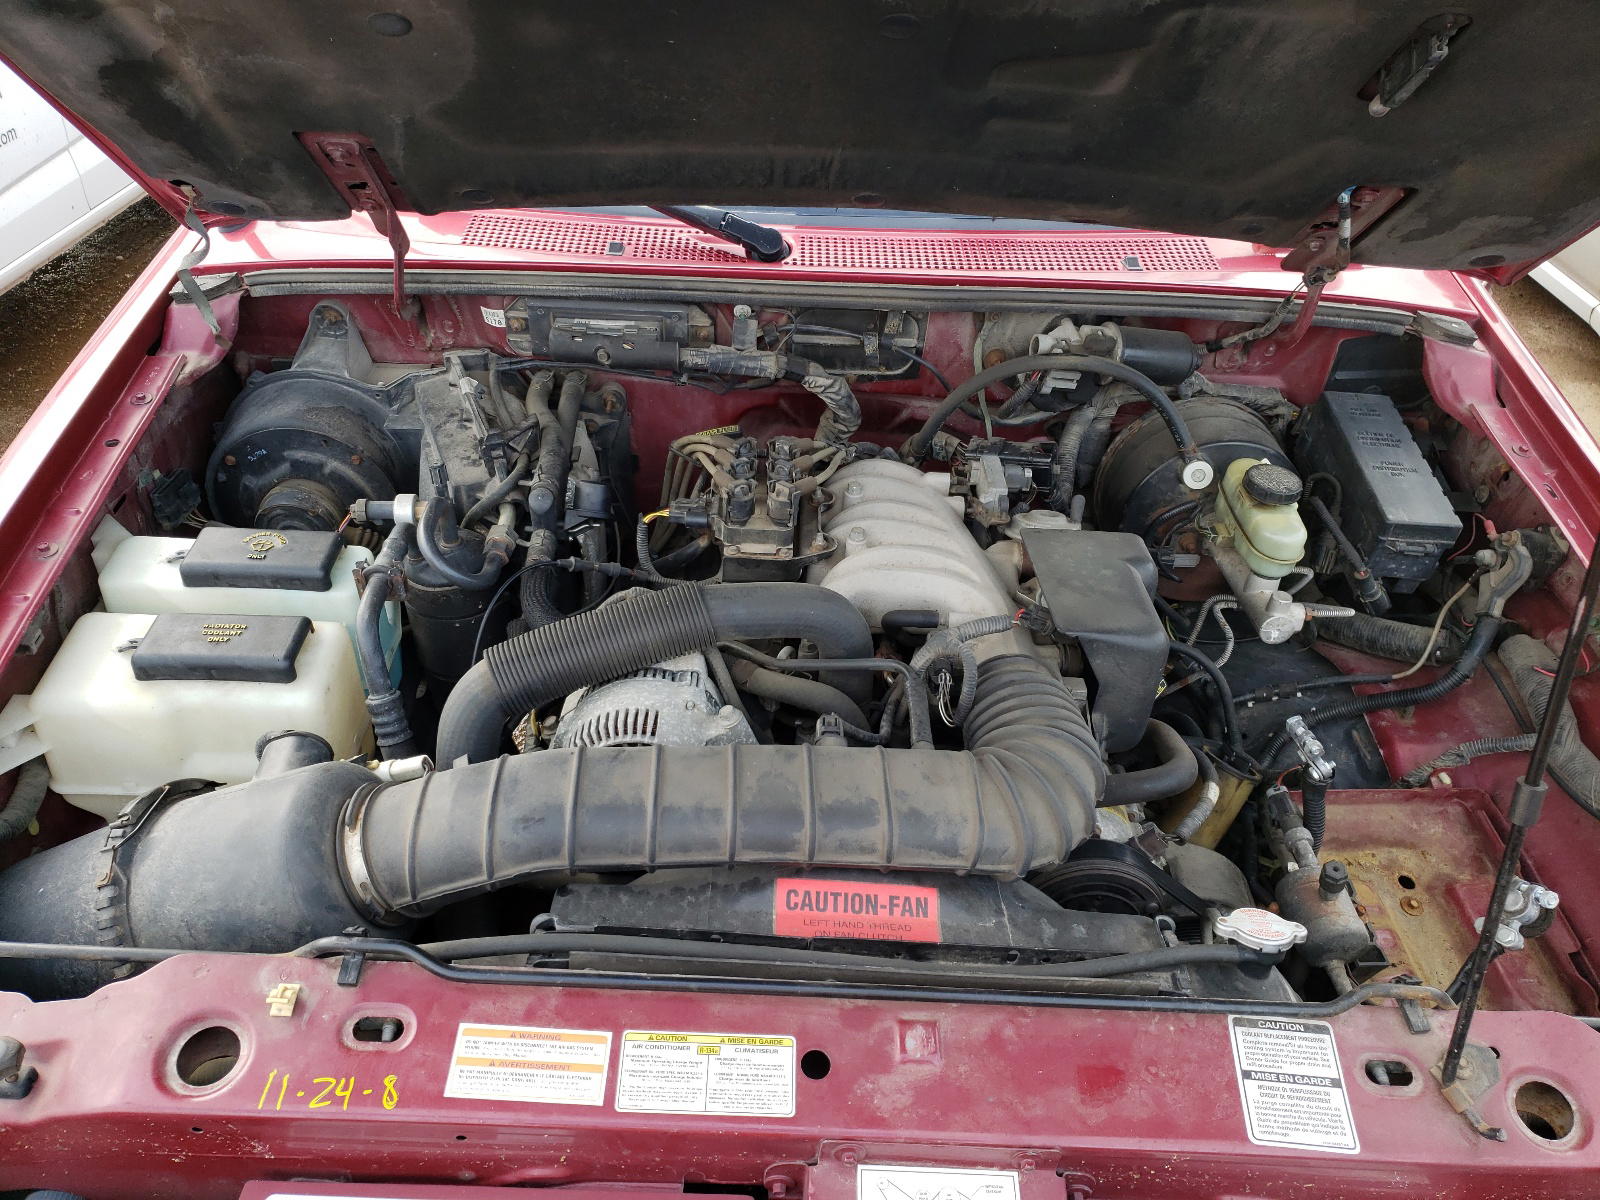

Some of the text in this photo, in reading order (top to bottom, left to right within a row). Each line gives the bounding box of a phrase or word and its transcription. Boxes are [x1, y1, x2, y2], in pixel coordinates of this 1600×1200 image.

[785, 888, 929, 919] CAUTION-FAN
[803, 919, 912, 932] LEFT HAND THREAD
[1258, 1020, 1305, 1032] CAUTION
[519, 1032, 562, 1041] WARNING
[499, 1061, 573, 1071] AVERTISSEMENT
[1251, 1071, 1333, 1087] MISE EN GARDE
